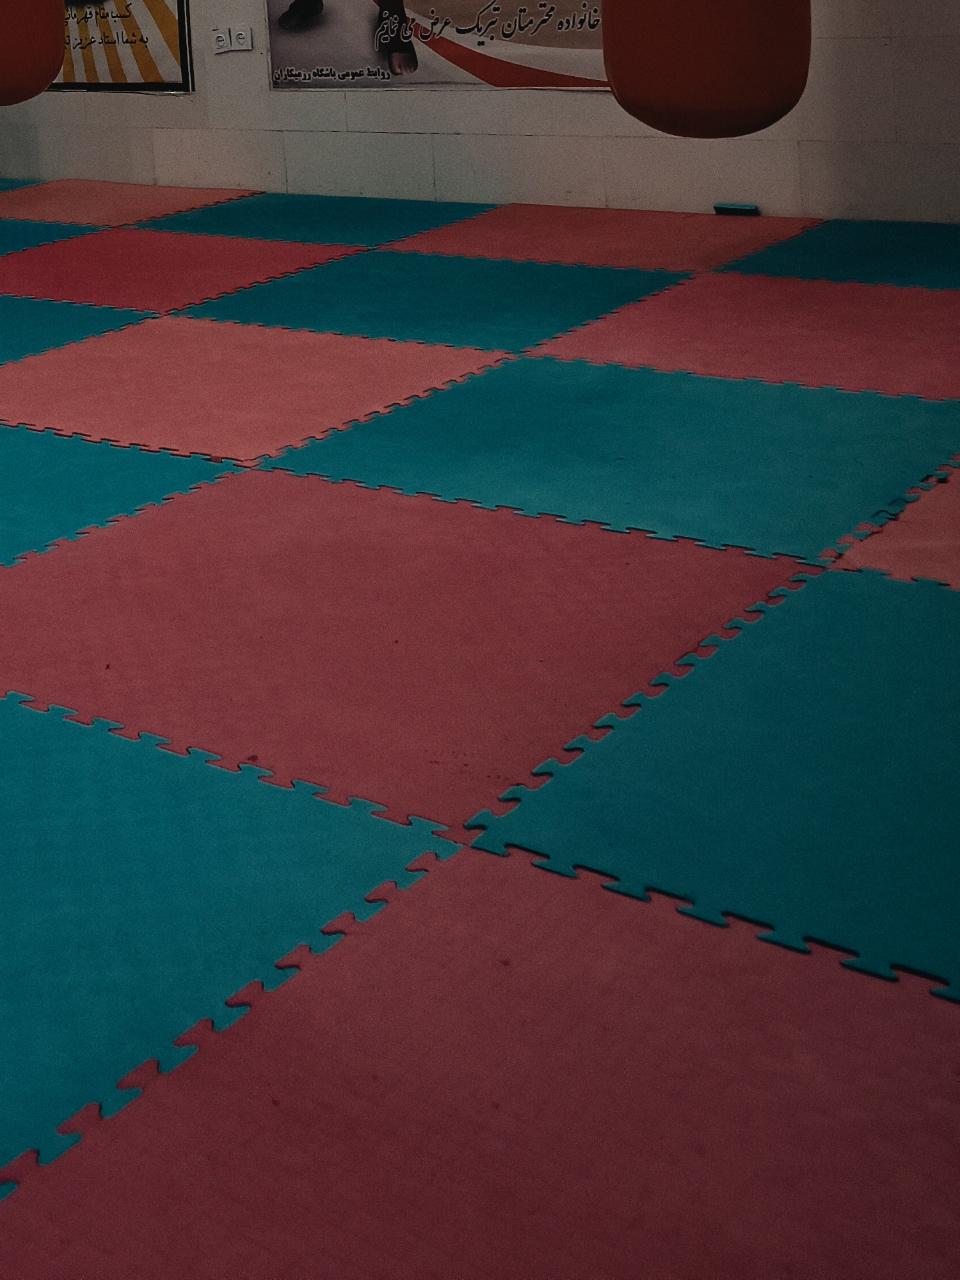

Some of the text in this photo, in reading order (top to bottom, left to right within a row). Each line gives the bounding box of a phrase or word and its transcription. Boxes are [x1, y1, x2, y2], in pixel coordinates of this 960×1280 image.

[94, 6, 109, 27] مقام
[111, 2, 132, 22] کسب
[556, 2, 602, 31] خانواده
[400, 18, 416, 42] می
[420, 8, 452, 42] عرض
[72, 35, 96, 50] عزیز
[98, 32, 120, 45] استاد
[122, 31, 137, 44] شما
[312, 66, 336, 81] باشگاه
[336, 70, 364, 81] عمومی
[366, 66, 390, 80] روابط
